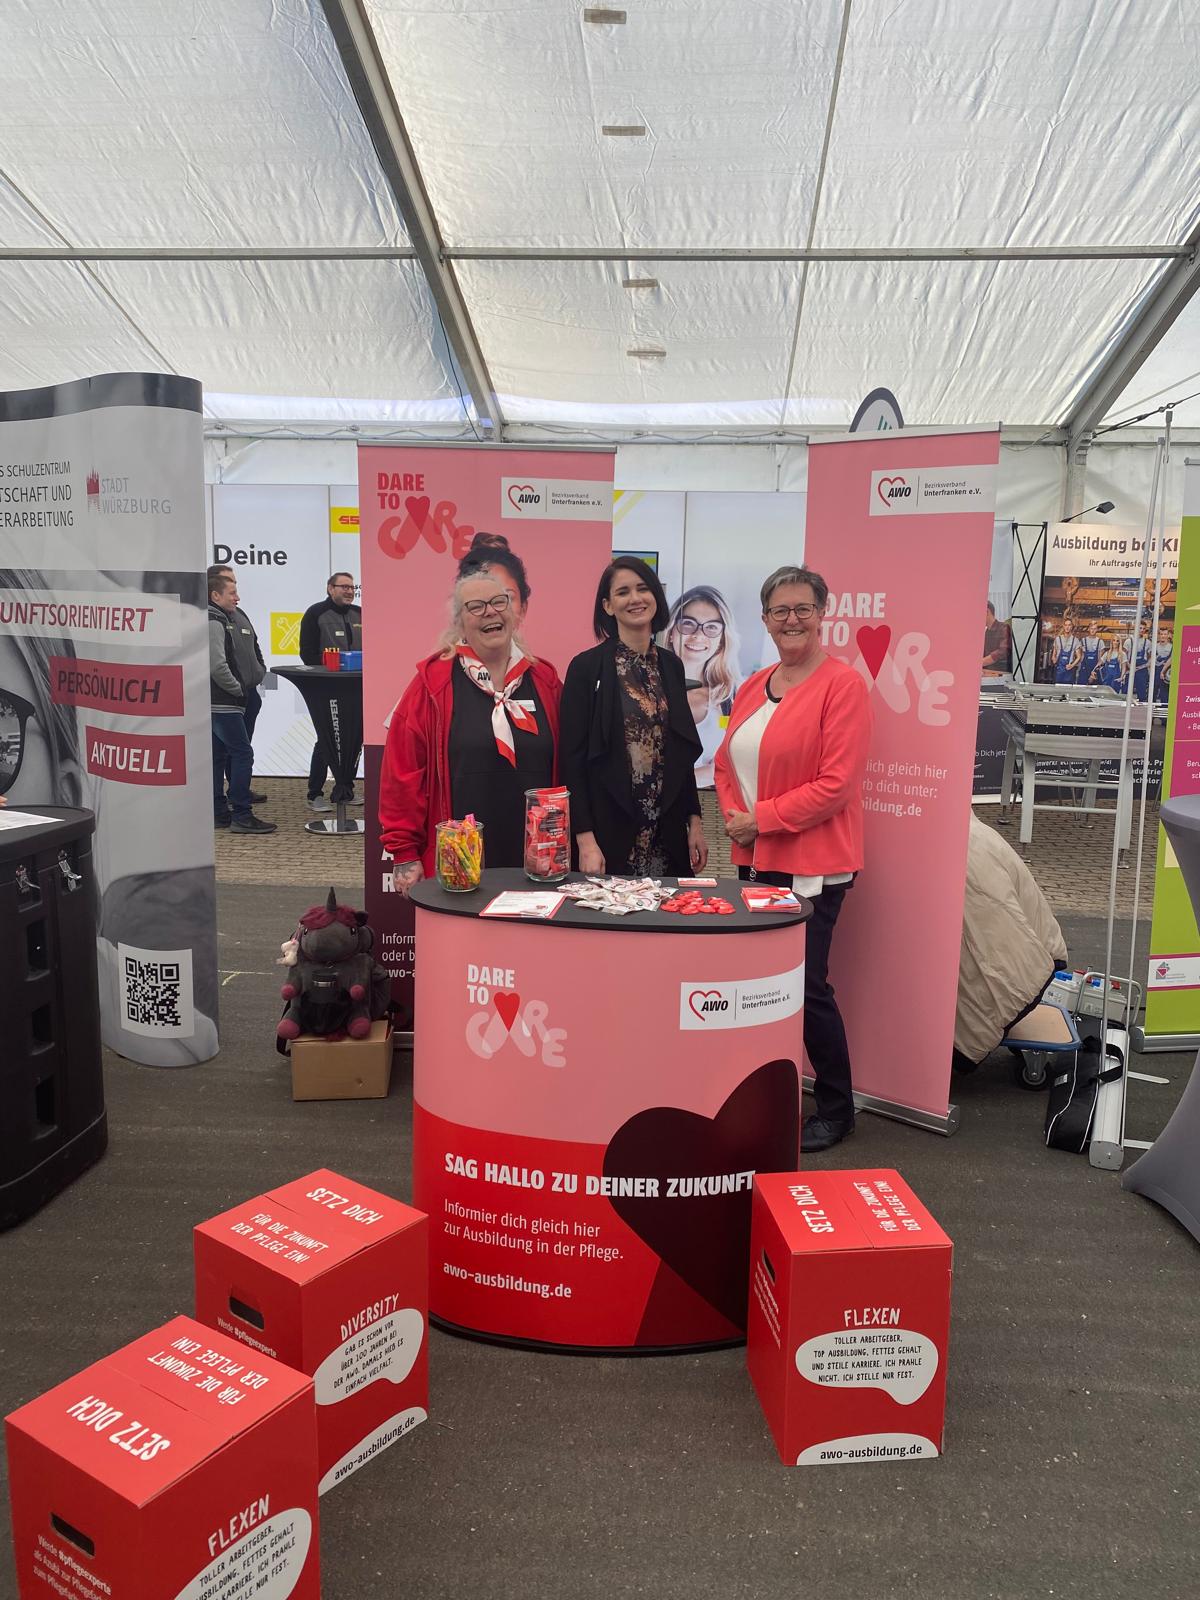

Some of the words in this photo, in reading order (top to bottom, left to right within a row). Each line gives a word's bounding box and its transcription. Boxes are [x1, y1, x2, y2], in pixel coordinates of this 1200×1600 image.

[7, 461, 71, 477] SCHULZENTRUM
[102, 478, 129, 493] STADT
[378, 472, 424, 492] DARE
[888, 486, 911, 498] AWO
[924, 488, 967, 497] Unterfranken
[925, 481, 966, 489] Bezirksverband
[51, 485, 71, 501] UND
[377, 492, 400, 510] TO
[518, 493, 540, 504] AWO
[552, 498, 590, 506] Unterfranken
[102, 498, 171, 514] WÜRZBURG
[214, 544, 287, 565] Deine
[1053, 535, 1127, 553] Ausbildung
[1101, 560, 1167, 568] Auftragsfetigr
[0, 602, 153, 632] UNFTSORIENTIERT
[821, 621, 849, 646] TO
[58, 669, 161, 704] PERSÖNLICH
[91, 741, 172, 774] AKTUELL
[888, 762, 921, 776] gleich
[925, 765, 947, 779] hier
[876, 780, 899, 794] dich
[904, 784, 938, 798] unter:
[382, 950, 405, 961] oder
[467, 963, 515, 989] DARE
[467, 984, 490, 1006] TO
[741, 997, 781, 1010] Unterfranken
[701, 1000, 728, 1012] AWO
[445, 1152, 478, 1180] SAG
[485, 1162, 545, 1190] HALLO
[551, 1172, 578, 1194] ZU
[585, 1175, 660, 1198] DEINER
[666, 1170, 756, 1198] ZUKUNFT
[788, 1185, 820, 1206] DICH
[306, 1187, 350, 1210] SETZ
[341, 1204, 384, 1226] DICH
[444, 1198, 498, 1225] Informier
[500, 1212, 527, 1230] dich
[531, 1218, 569, 1235] gleich
[574, 1222, 600, 1238] hier
[801, 1209, 835, 1233] SETZ
[230, 1222, 255, 1236] DER
[250, 1232, 289, 1254] PFLEGE
[284, 1249, 310, 1264] EIN!
[250, 1213, 273, 1228] FÜR
[267, 1222, 289, 1235] DIE
[283, 1230, 329, 1253] ZUKUNFT
[444, 1222, 461, 1236] zur
[463, 1226, 533, 1254] Ausbildung
[536, 1239, 549, 1254] in
[553, 1241, 575, 1257] der
[579, 1244, 624, 1262] Pflege.
[443, 1262, 572, 1298] awo-ausbildung.de
[341, 1293, 400, 1342] DIVERSITY
[844, 1308, 900, 1327] FLEXEN
[171, 1336, 202, 1355] EIN!
[344, 1344, 356, 1356] GAB
[358, 1338, 365, 1347] ES
[366, 1327, 383, 1343] SCHON
[384, 1320, 394, 1332] VOR
[355, 1349, 368, 1362] 100
[369, 1338, 388, 1354] JAHREN
[389, 1331, 397, 1341] BEI
[834, 1336, 857, 1345] TOLLER
[195, 1345, 245, 1377] PFLEGE
[814, 1350, 825, 1358] TOP
[872, 1347, 895, 1356] FETTES
[898, 1346, 922, 1354] GEHALT
[147, 1350, 200, 1380] ZUKUNFT
[333, 1377, 344, 1389] DER
[362, 1352, 383, 1371] DAMALS
[397, 1338, 404, 1348] ES
[812, 1363, 825, 1371] UND
[827, 1362, 849, 1370] STEILE
[852, 1360, 882, 1369] KARRIERE.
[885, 1359, 896, 1367] ICH
[899, 1358, 922, 1366] PRAHLE
[195, 1375, 223, 1393] DIE
[239, 1372, 270, 1390] DER
[345, 1375, 367, 1394] EINFACH
[369, 1359, 393, 1379] VIELFALT.
[818, 1374, 839, 1382] NICHT.
[843, 1373, 853, 1381] ICH
[857, 1372, 880, 1381] STELLE
[882, 1371, 894, 1379] NUR
[897, 1371, 915, 1379] FEST.
[217, 1388, 245, 1405] FÜR
[66, 1395, 124, 1432] DICH
[109, 1420, 171, 1461] SETZ
[334, 1416, 415, 1481] awo-ausbildung.de
[820, 1444, 922, 1460] awo-ausbildung.de
[208, 1494, 270, 1557] FLEXEN
[243, 1544, 267, 1570] FETTES
[270, 1522, 294, 1550] GEHALT
[258, 1559, 269, 1573] ICH
[271, 1537, 296, 1563] PRAHLE
[200, 1561, 225, 1588] TOLLER
[256, 1574, 268, 1590] NUR
[271, 1558, 289, 1577] FEST.
